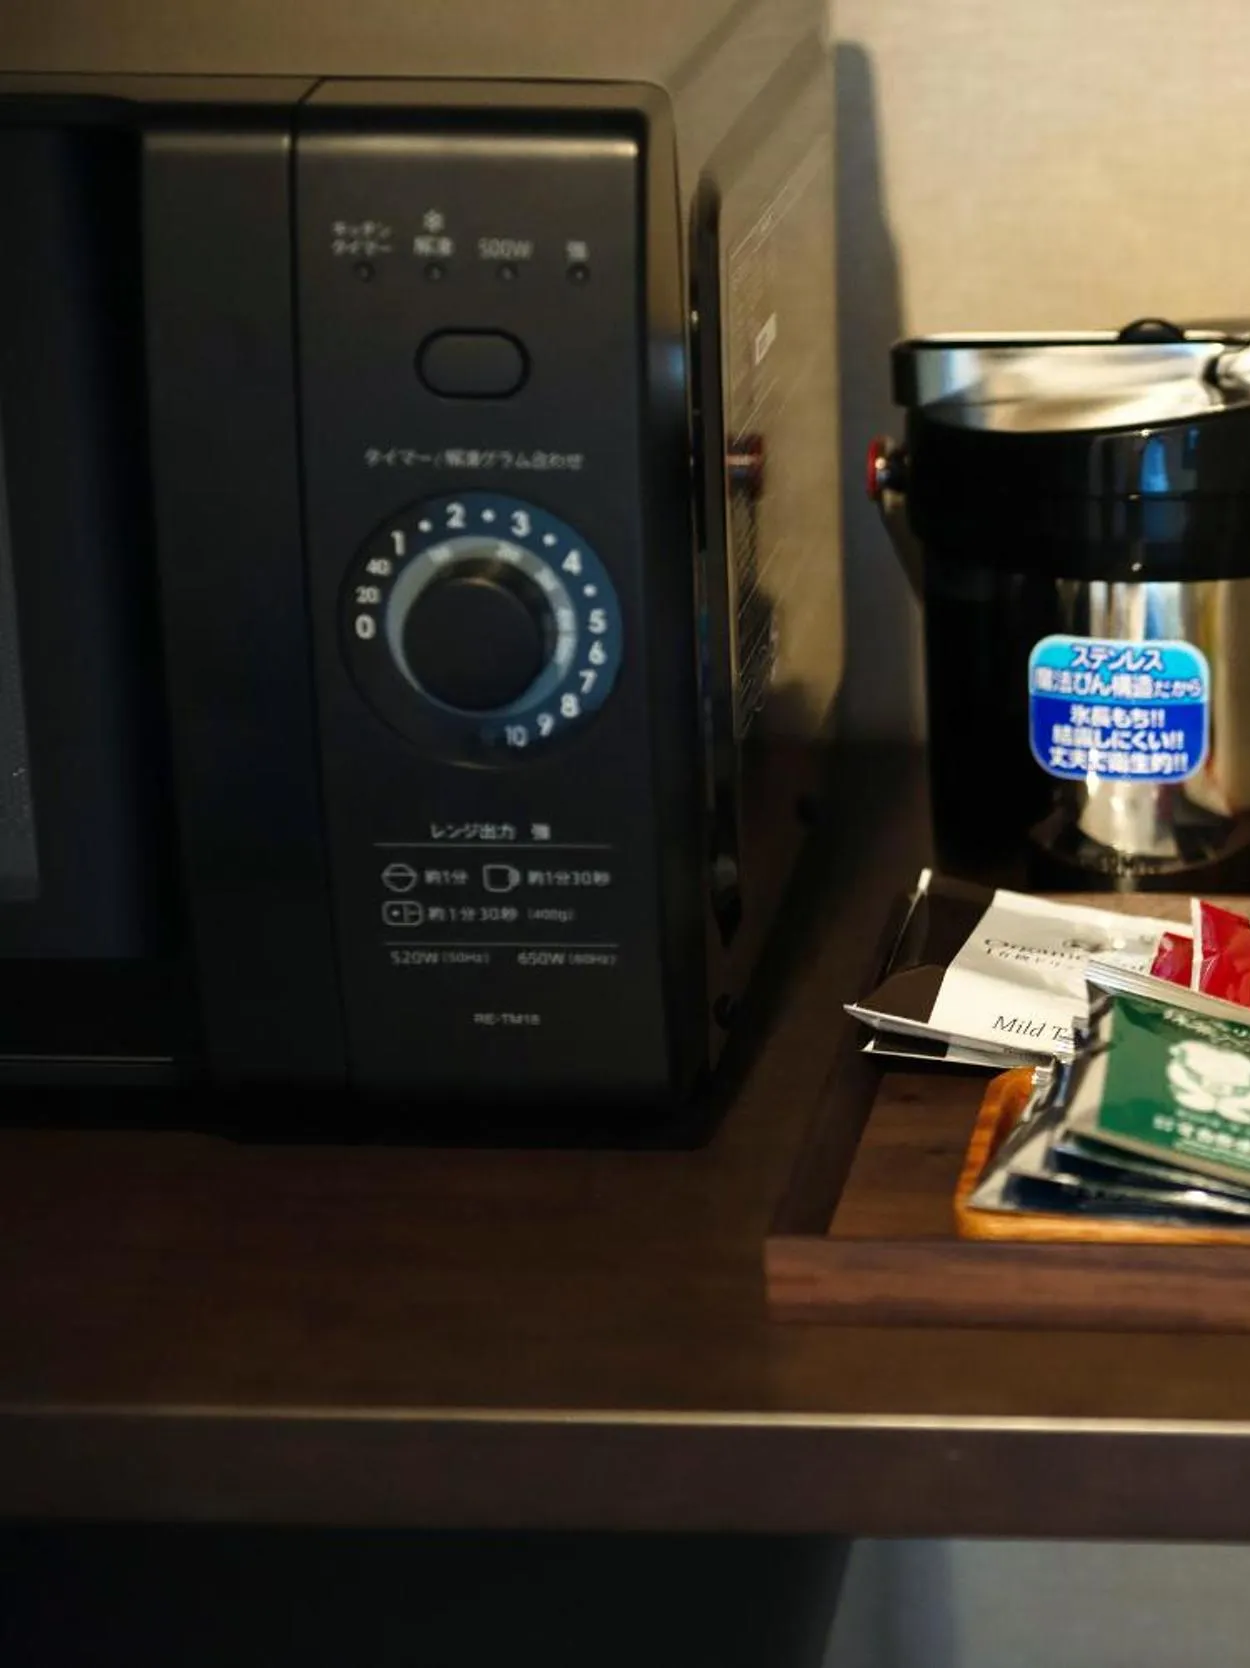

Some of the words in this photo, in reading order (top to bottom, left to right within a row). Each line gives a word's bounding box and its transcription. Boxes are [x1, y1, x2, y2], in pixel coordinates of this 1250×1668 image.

[478, 238, 533, 259] 500W
[446, 503, 466, 529] 2
[510, 510, 530, 537] 3
[391, 530, 405, 556] 1
[366, 558, 391, 576] 40
[562, 549, 582, 575] 4
[356, 586, 379, 604] 20
[355, 614, 376, 639] 0
[588, 608, 607, 634] 5
[588, 641, 607, 665] 6
[1071, 644, 1164, 671] ステンレス
[579, 669, 597, 694] 7
[560, 692, 580, 718] 8
[505, 725, 528, 747] 10
[536, 713, 554, 736] 9
[430, 823, 516, 840] レンジ出力
[992, 1015, 1046, 1039] Mild
